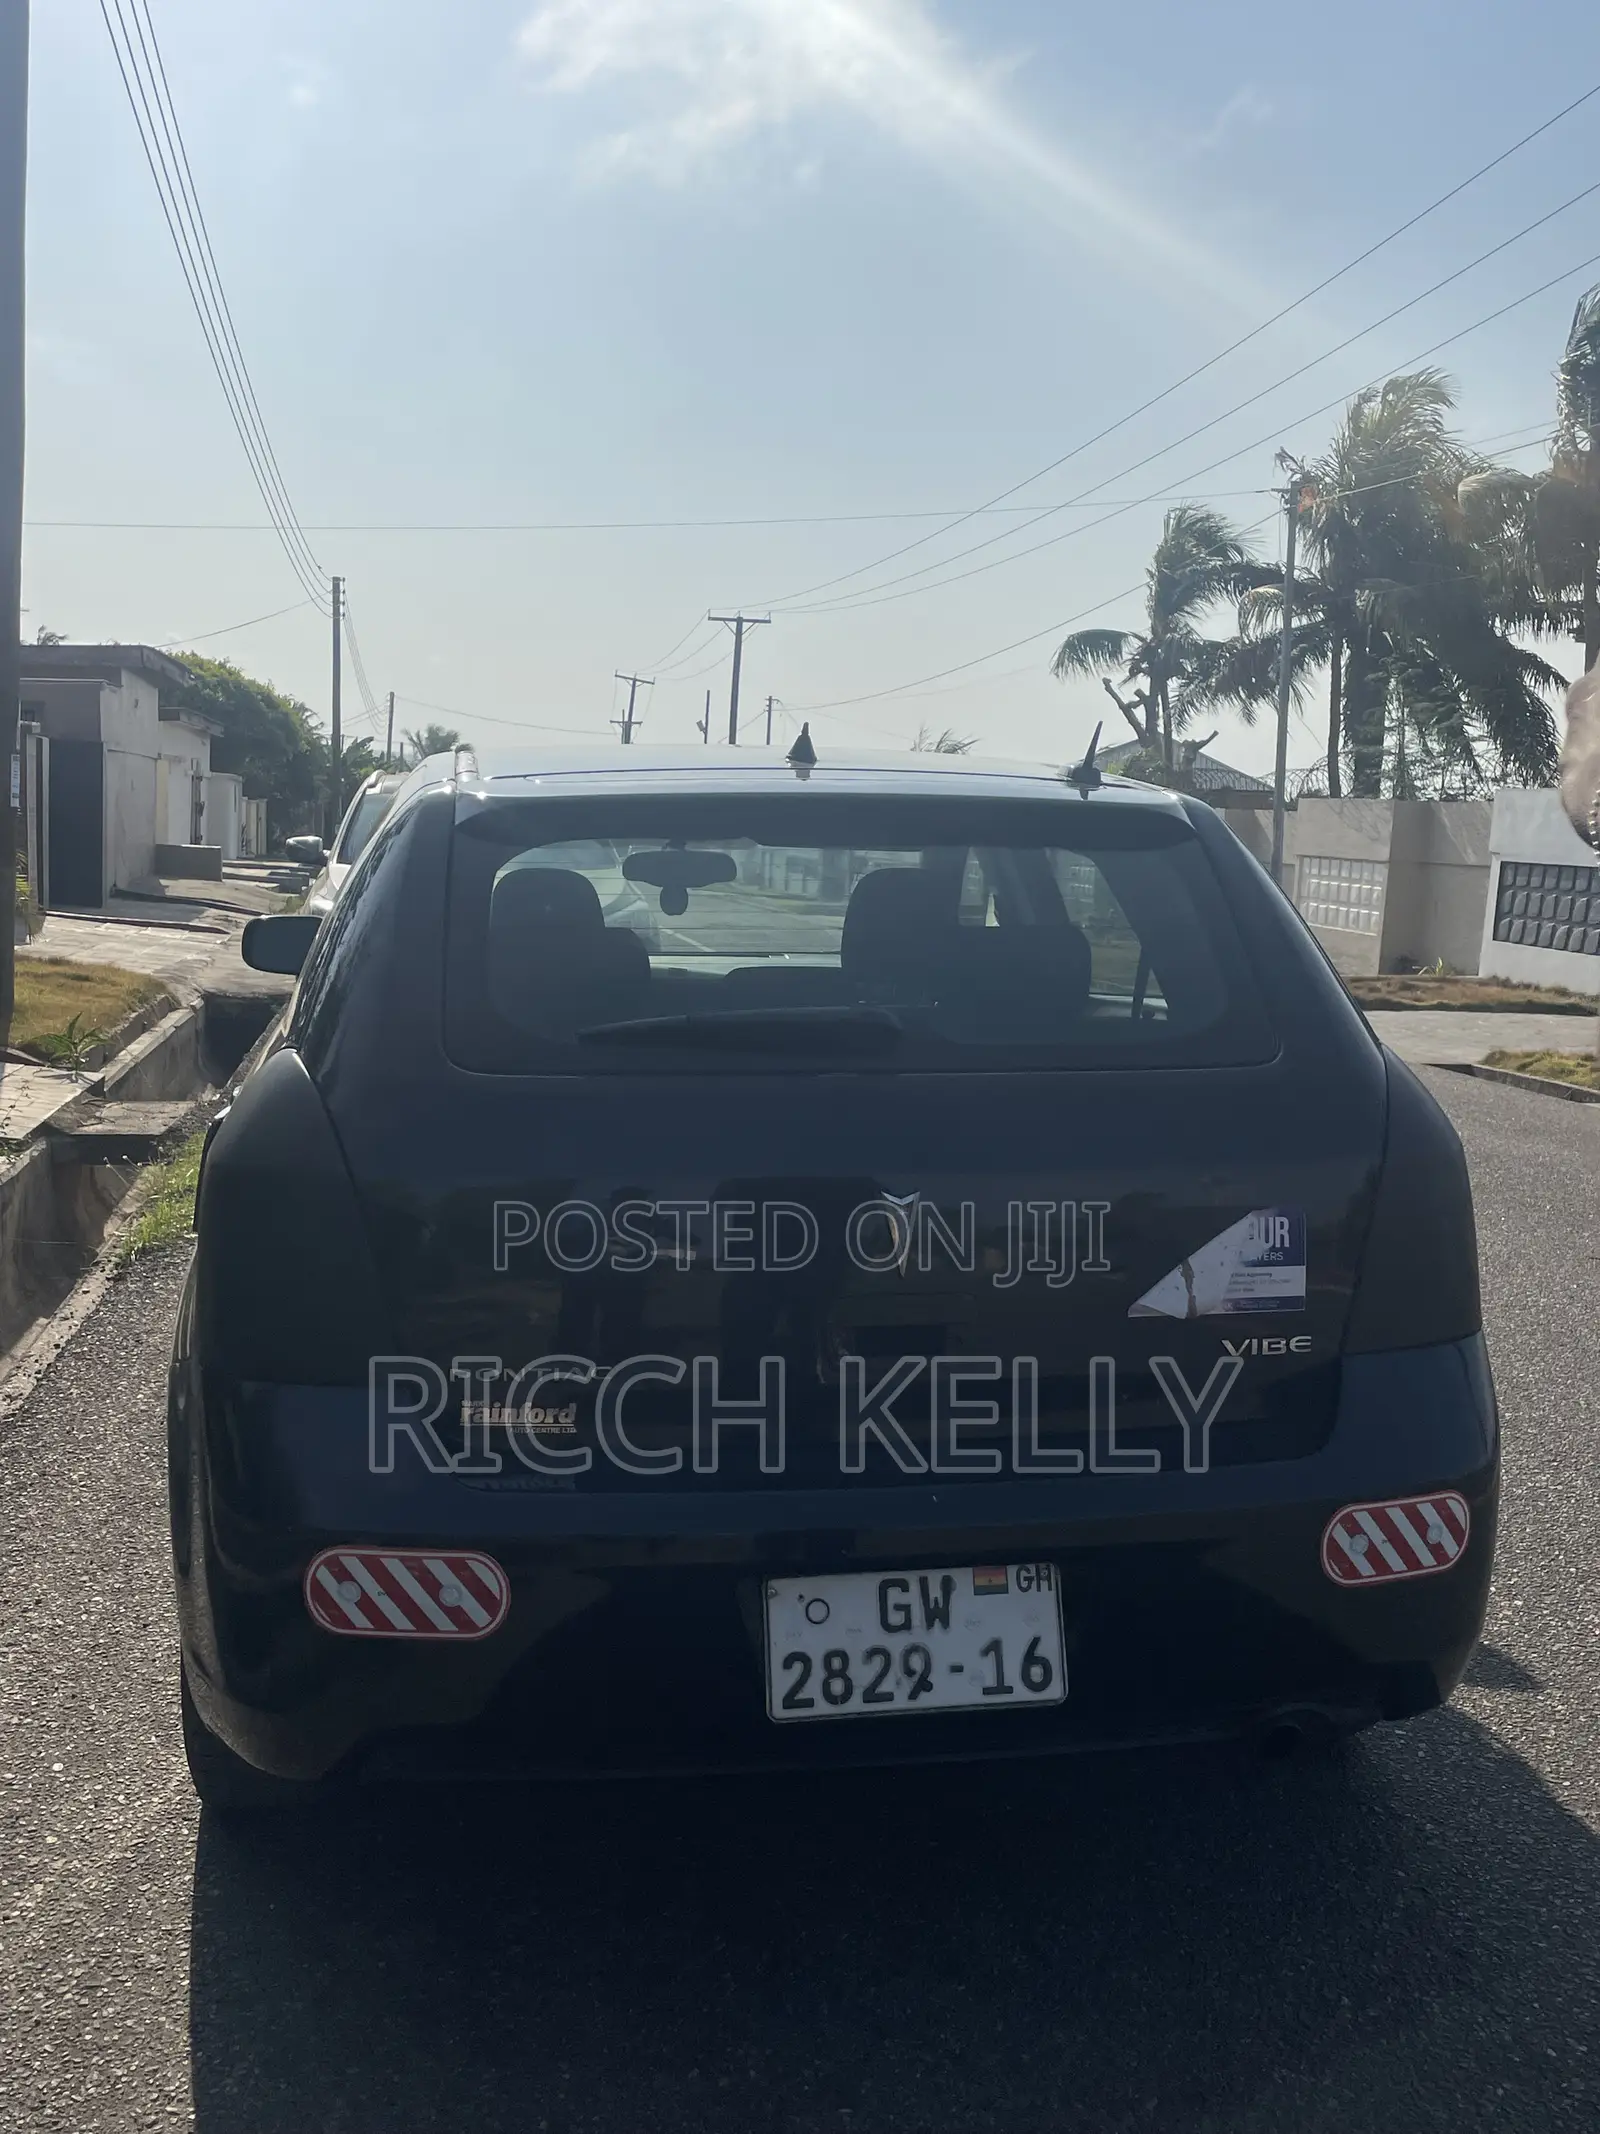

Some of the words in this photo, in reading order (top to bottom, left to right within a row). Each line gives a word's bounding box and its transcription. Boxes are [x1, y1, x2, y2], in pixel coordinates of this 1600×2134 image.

[1221, 1336, 1312, 1357] VIBE
[449, 1366, 612, 1382] PONTIAC
[460, 1402, 577, 1424] rainford
[878, 1574, 957, 1634] GW
[1015, 1563, 1053, 1593] GH
